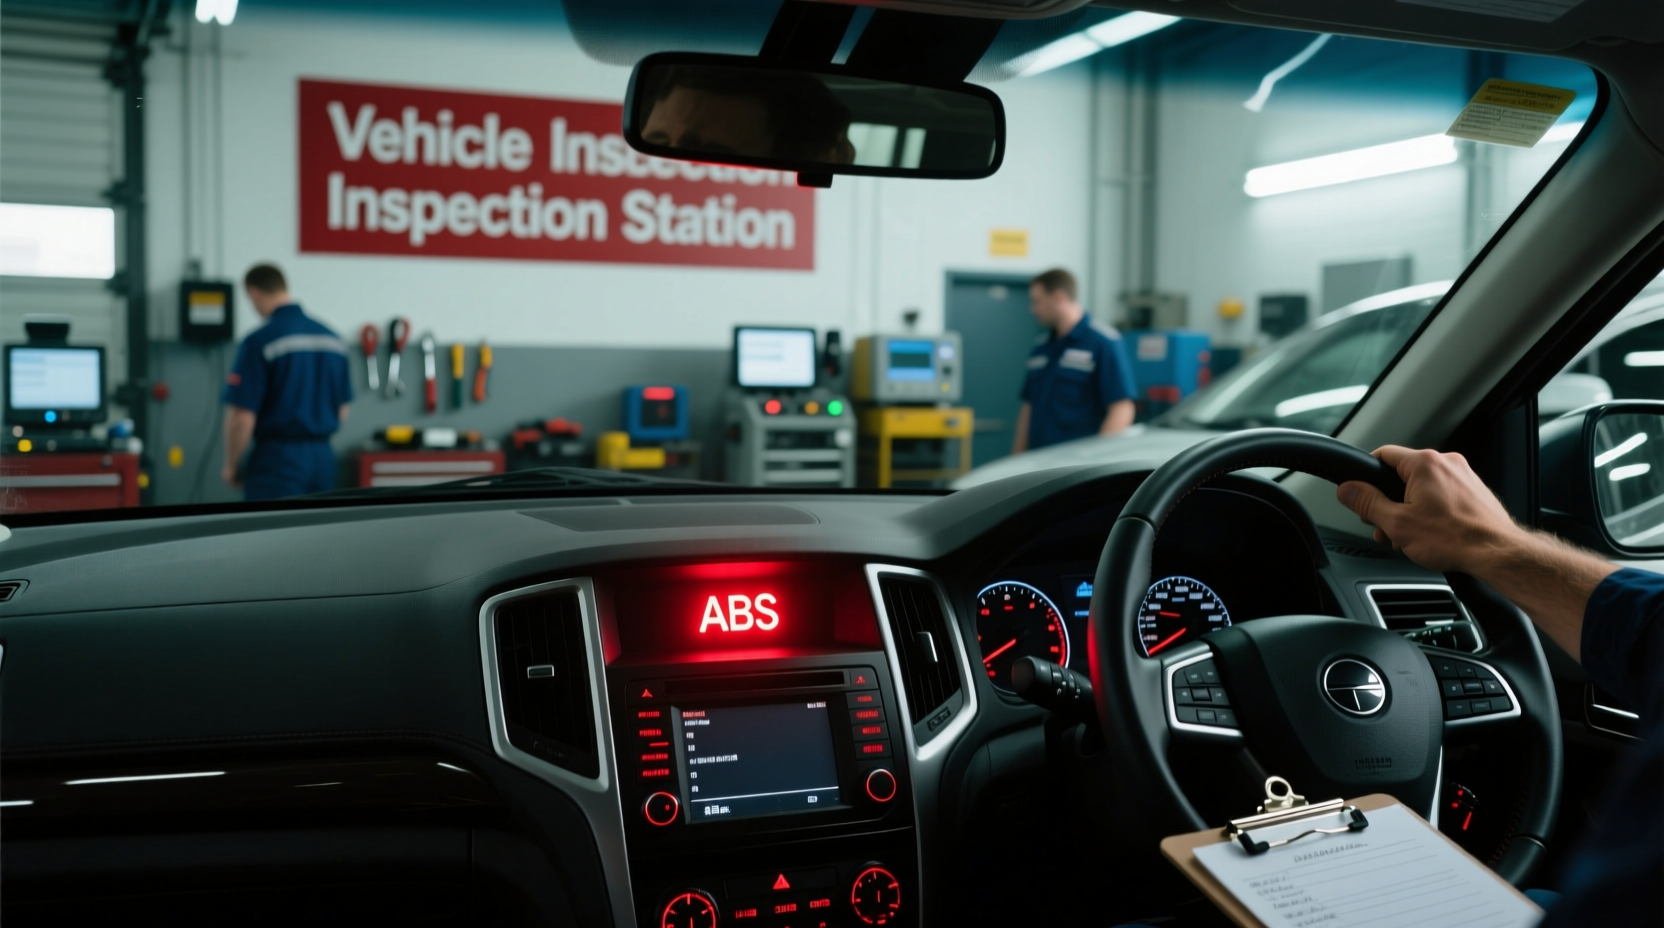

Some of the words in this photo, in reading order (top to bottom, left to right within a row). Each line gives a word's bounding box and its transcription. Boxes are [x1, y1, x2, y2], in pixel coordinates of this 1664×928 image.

[327, 101, 533, 170] Vehicle
[327, 172, 608, 246] Inspection
[620, 188, 796, 250] Station
[699, 592, 780, 634] ABS
